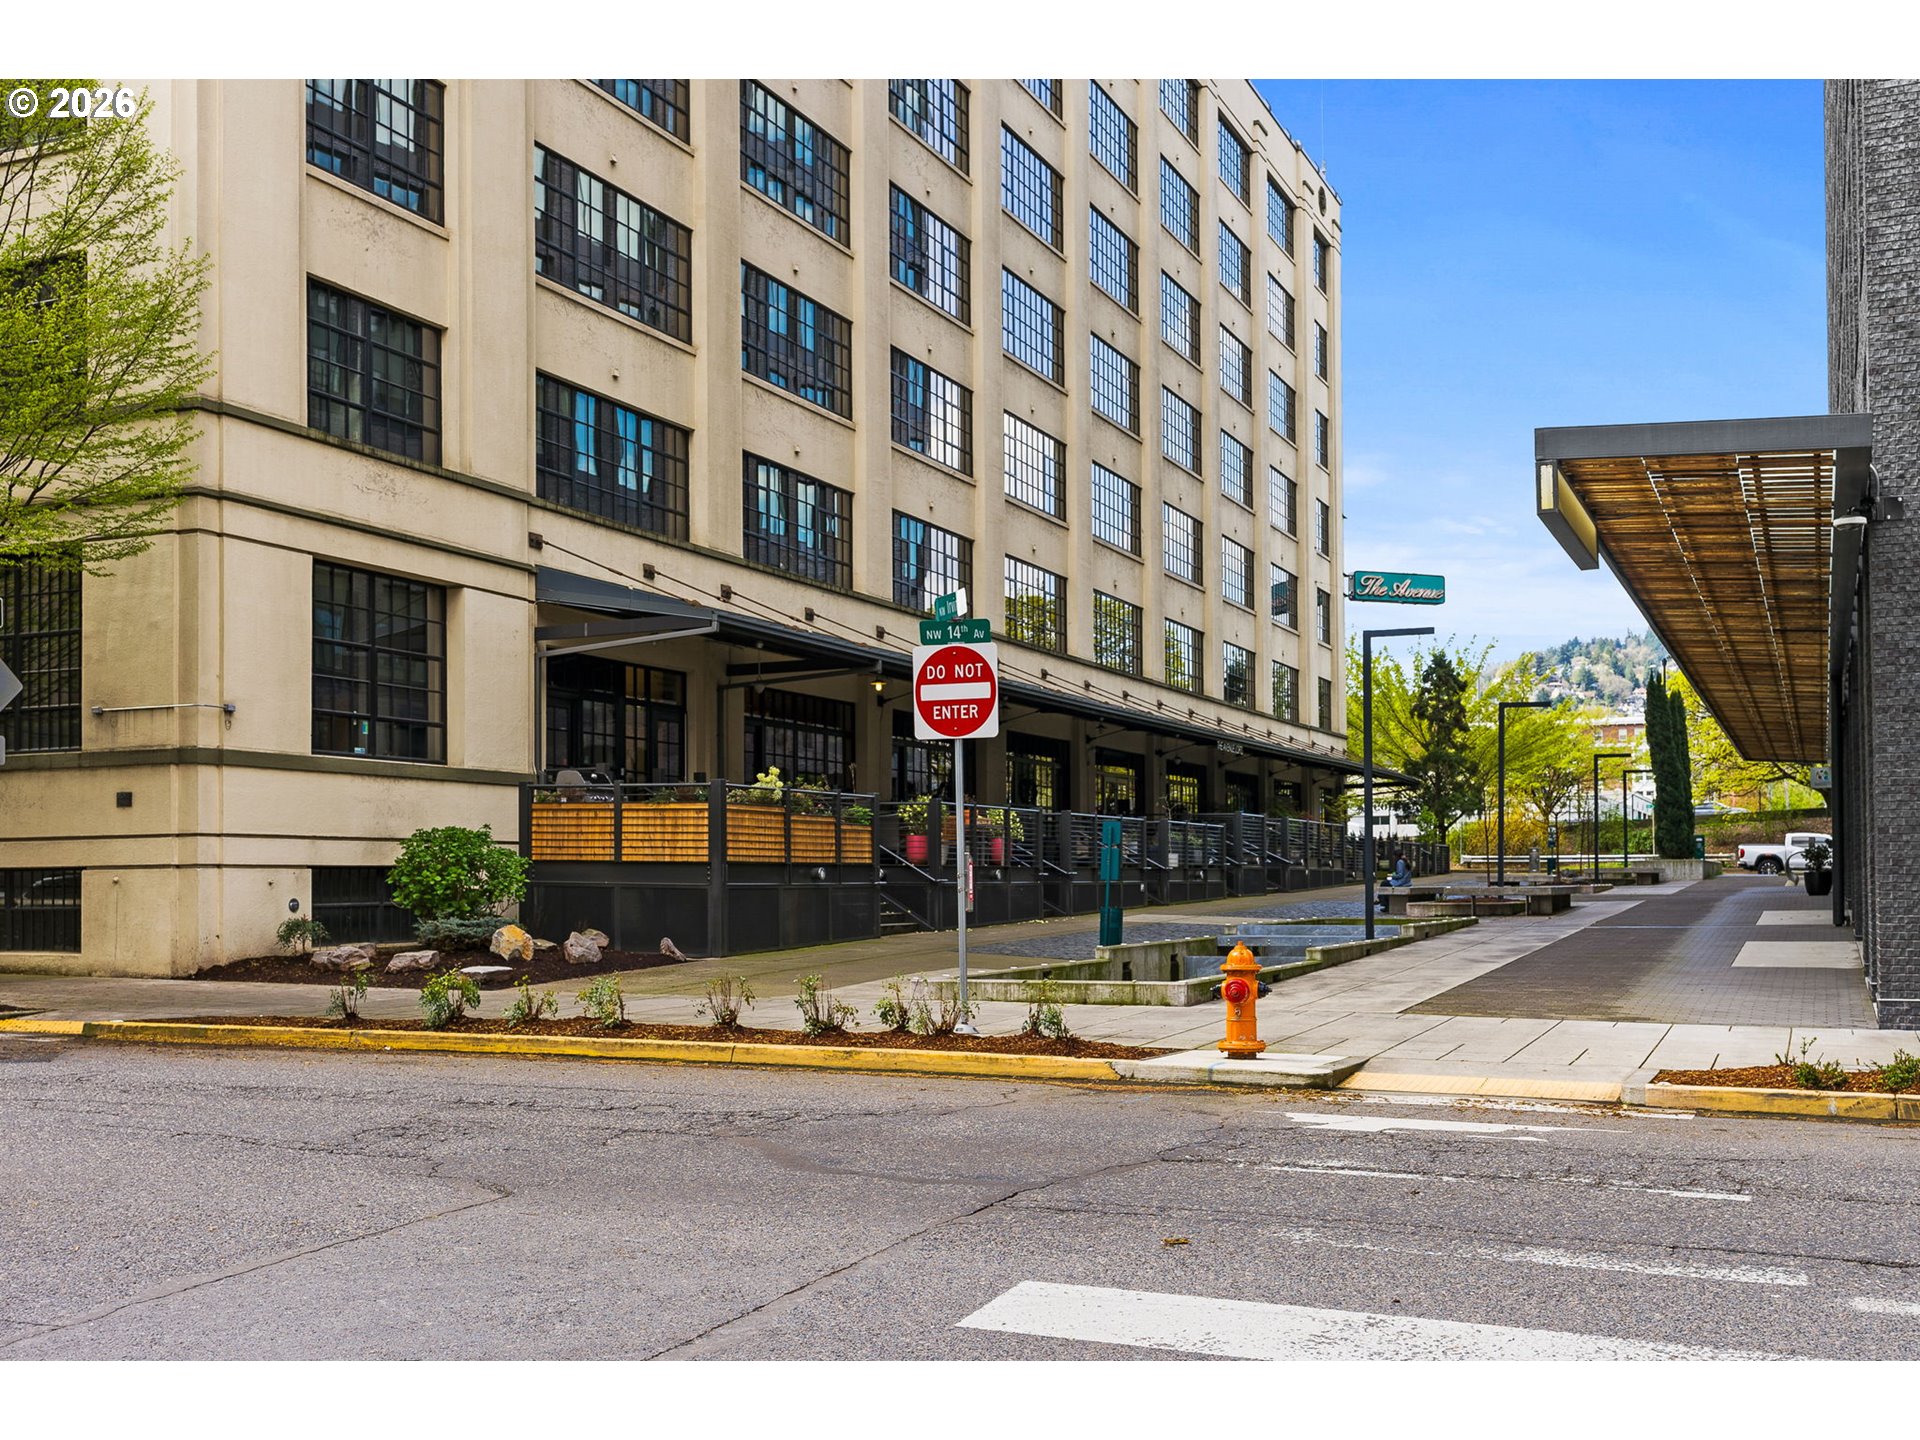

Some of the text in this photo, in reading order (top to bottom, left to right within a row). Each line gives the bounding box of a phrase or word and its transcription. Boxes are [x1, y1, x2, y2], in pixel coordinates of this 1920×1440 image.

[1356, 575, 1444, 599] The Avenue
[926, 630, 942, 640] NW
[947, 624, 969, 639] 14th
[926, 663, 983, 680] DO NOT
[933, 704, 979, 720] ENTER
